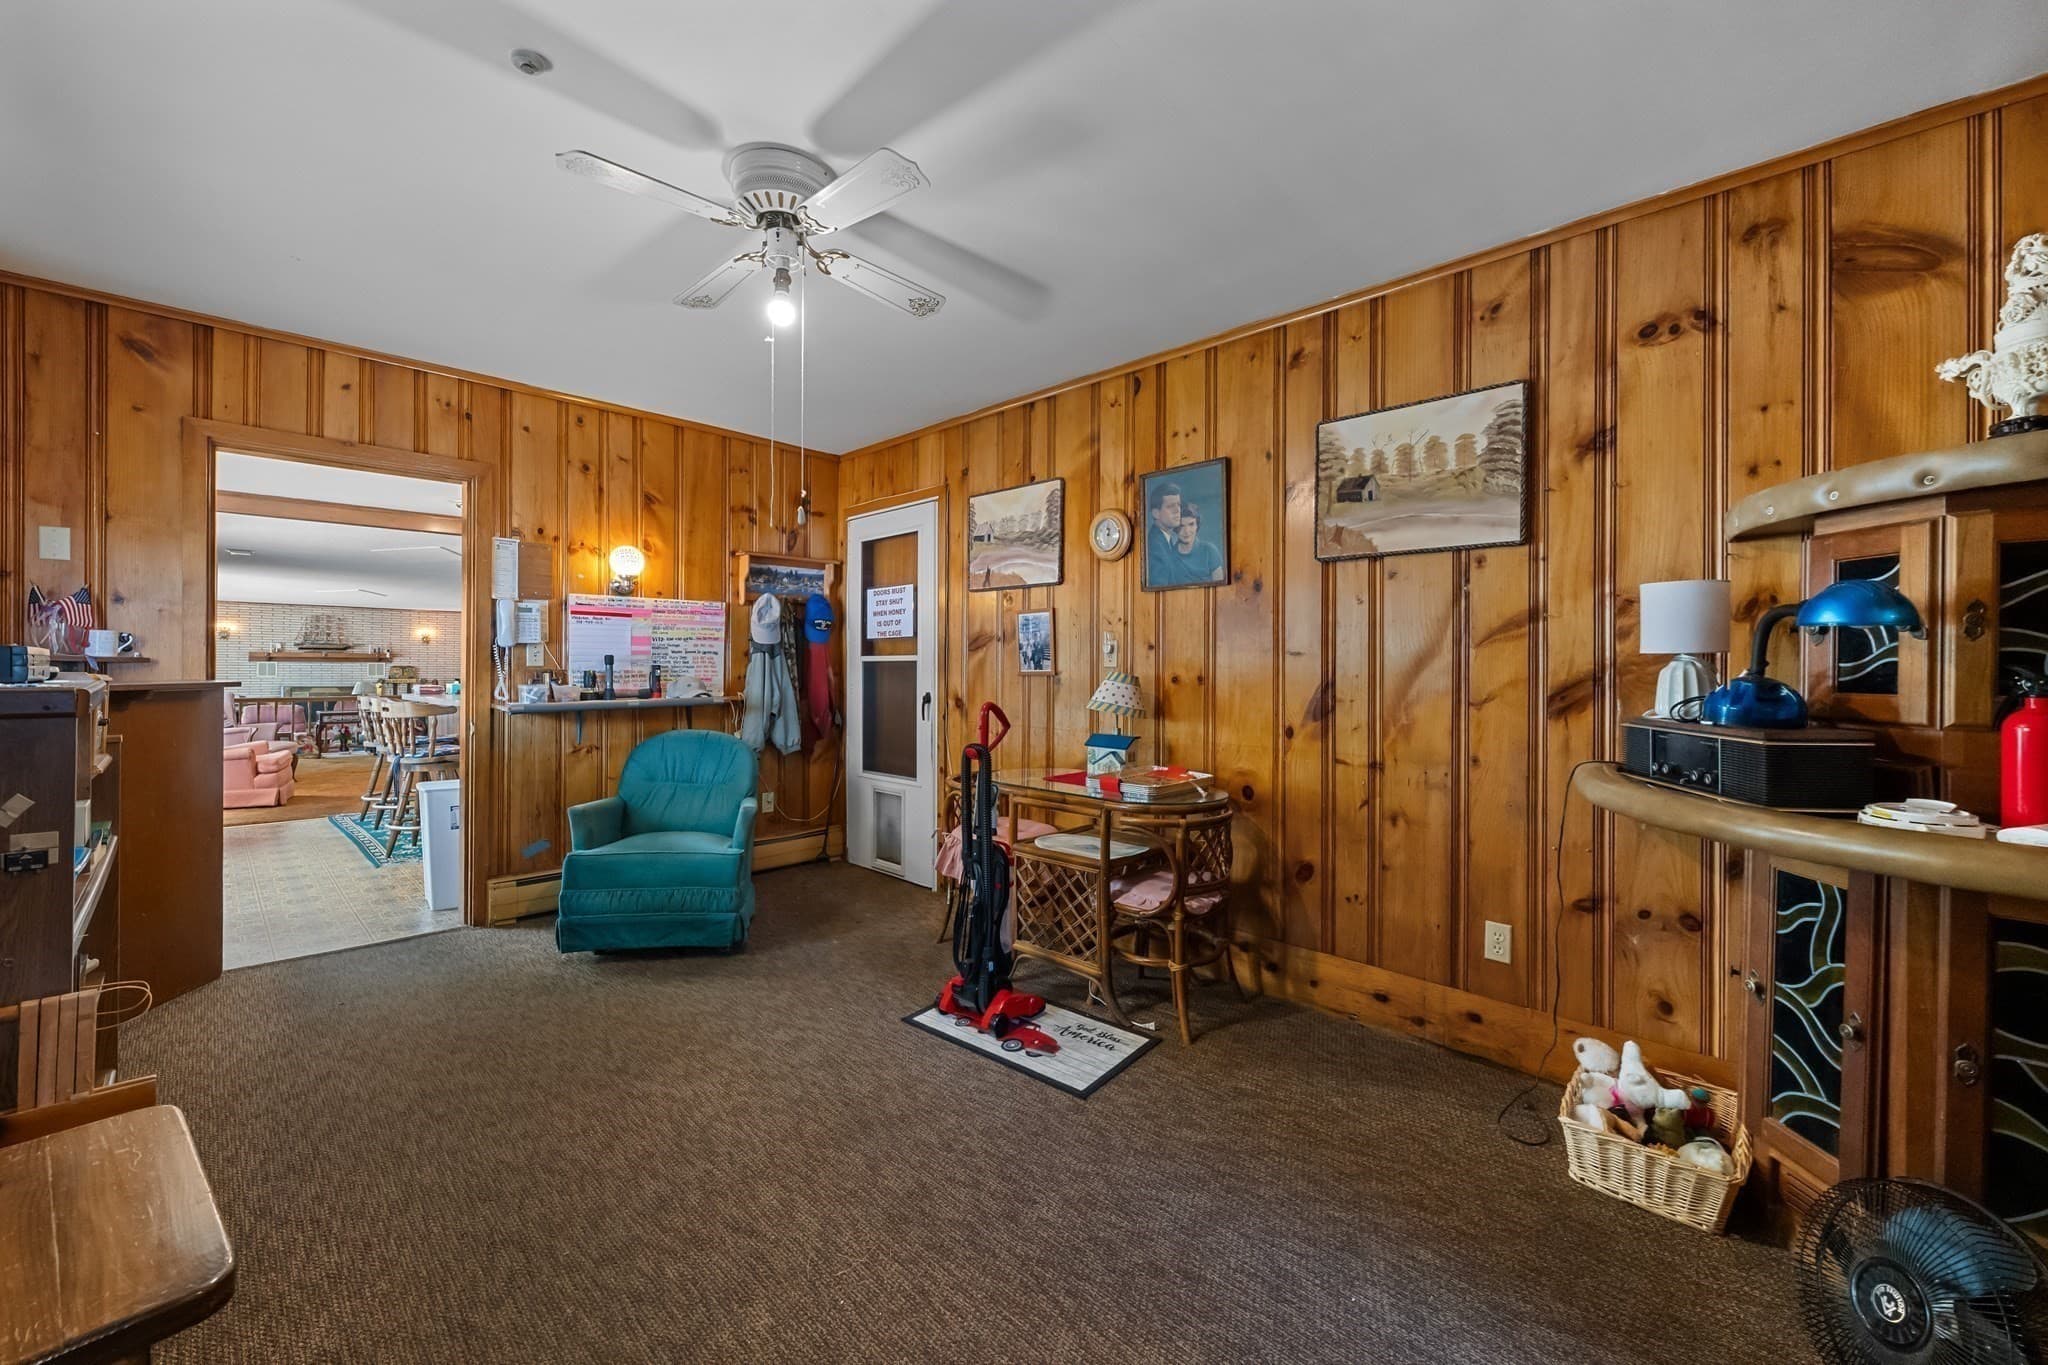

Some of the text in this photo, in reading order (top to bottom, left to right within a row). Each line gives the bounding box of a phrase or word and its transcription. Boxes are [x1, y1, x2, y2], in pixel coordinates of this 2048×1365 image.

[873, 587, 906, 597] DOORS MUST
[888, 608, 906, 616] HONEY
[1055, 1024, 1115, 1052] America
